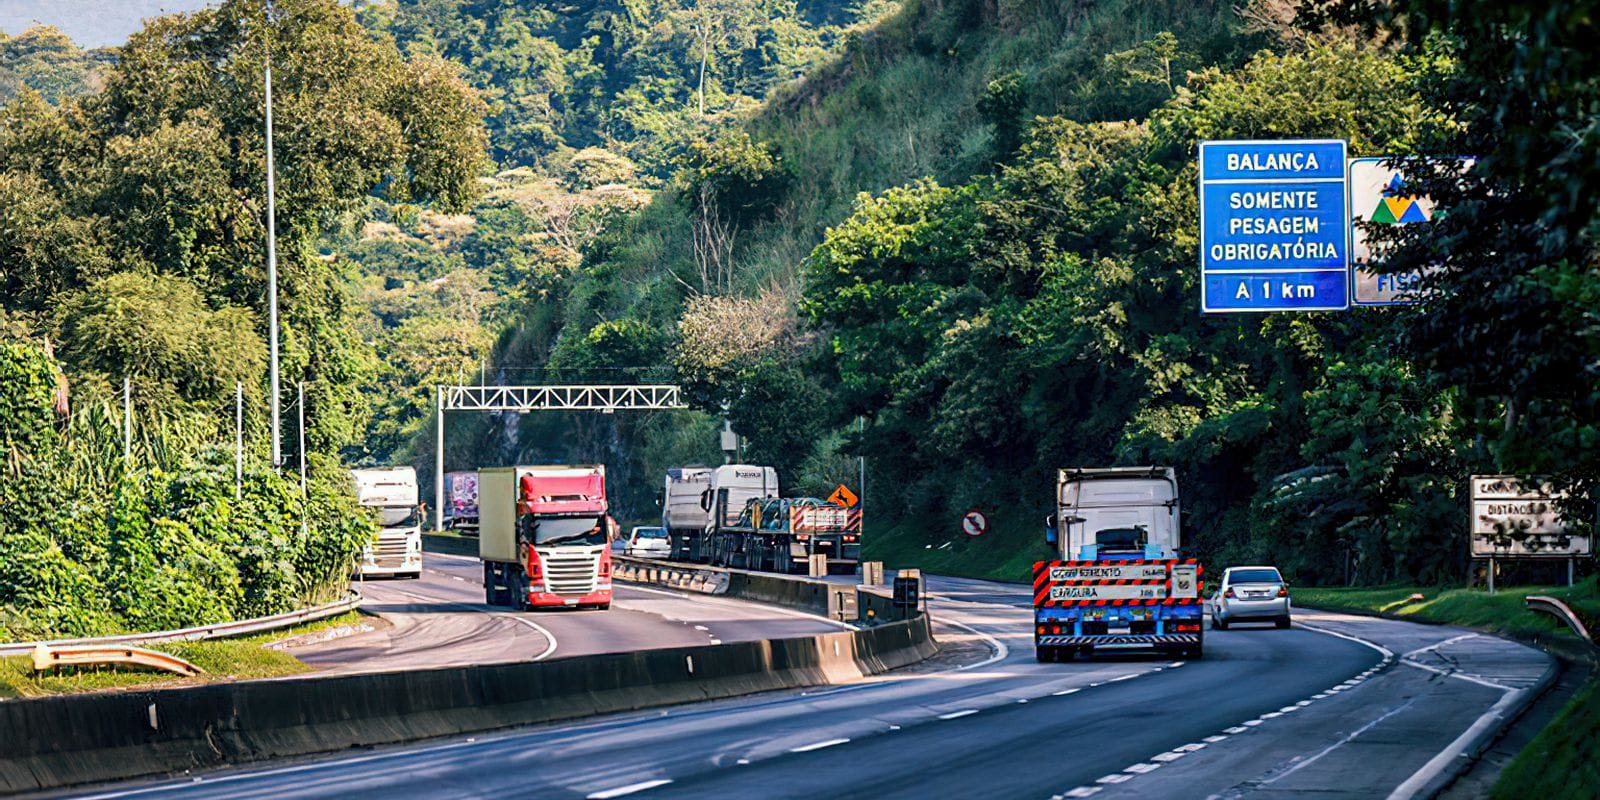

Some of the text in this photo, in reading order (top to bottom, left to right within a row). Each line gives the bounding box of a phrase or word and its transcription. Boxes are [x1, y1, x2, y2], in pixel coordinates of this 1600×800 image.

[1227, 152, 1319, 172] BALANÇA
[1229, 191, 1319, 210] SOMENTE
[1230, 216, 1319, 235] PESAGEM
[1210, 236, 1339, 261] OBRIGATÓRIA
[1235, 281, 1315, 299] A 1 km
